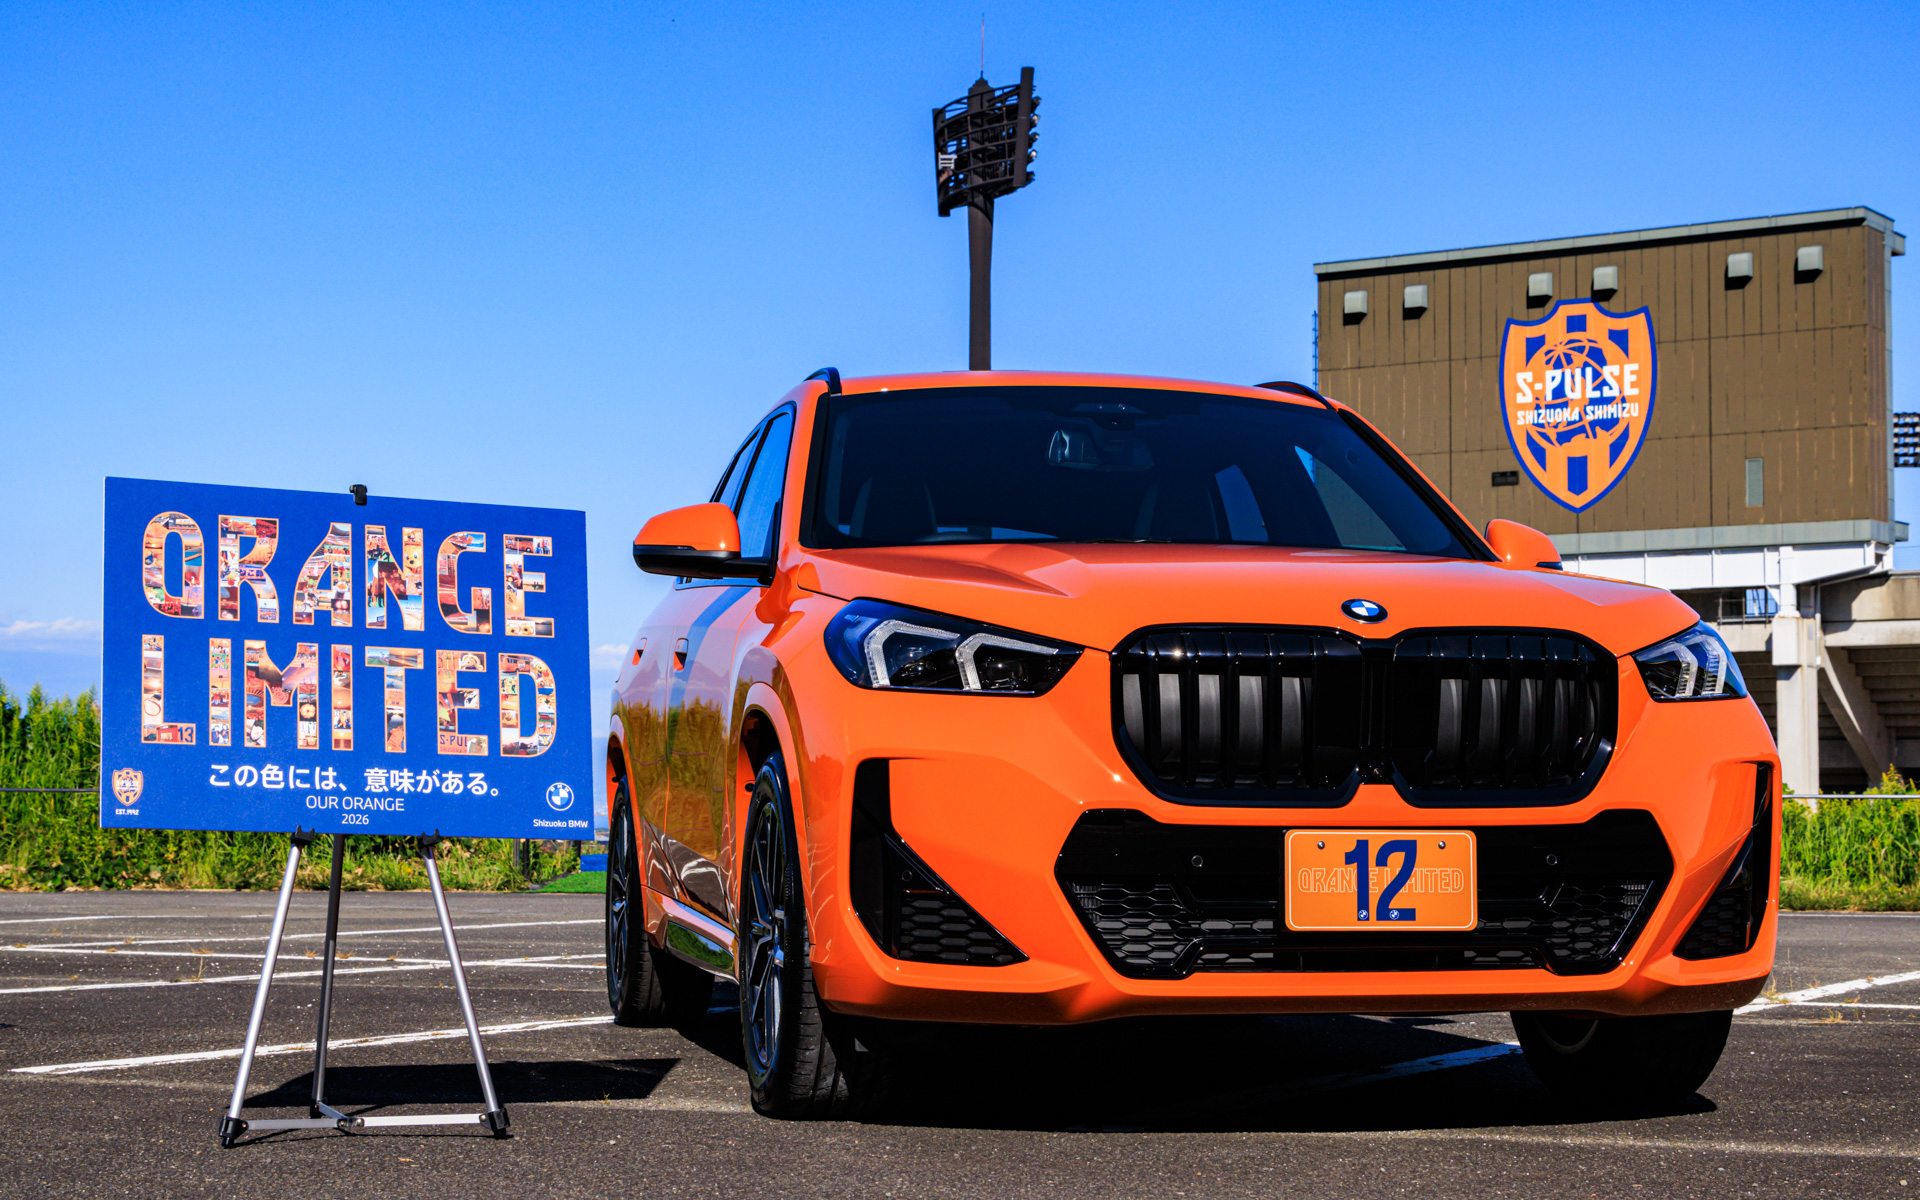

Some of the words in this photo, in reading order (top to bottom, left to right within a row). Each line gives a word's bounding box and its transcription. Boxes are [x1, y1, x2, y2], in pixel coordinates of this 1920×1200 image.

[1516, 363, 1639, 404] S-PULSE
[1516, 406, 1580, 425] SHIZUOKA
[1585, 402, 1639, 420] SHIMIZU
[142, 511, 554, 638] ORANGE
[141, 634, 557, 758] LIMITED
[209, 763, 499, 797] この色には、意味がある。
[306, 795, 339, 810] OUR
[342, 796, 405, 811] ORANGE
[341, 813, 369, 825] 2026
[533, 818, 567, 828] Shizuoka
[568, 819, 589, 828] BMW
[1344, 839, 1417, 921] 12
